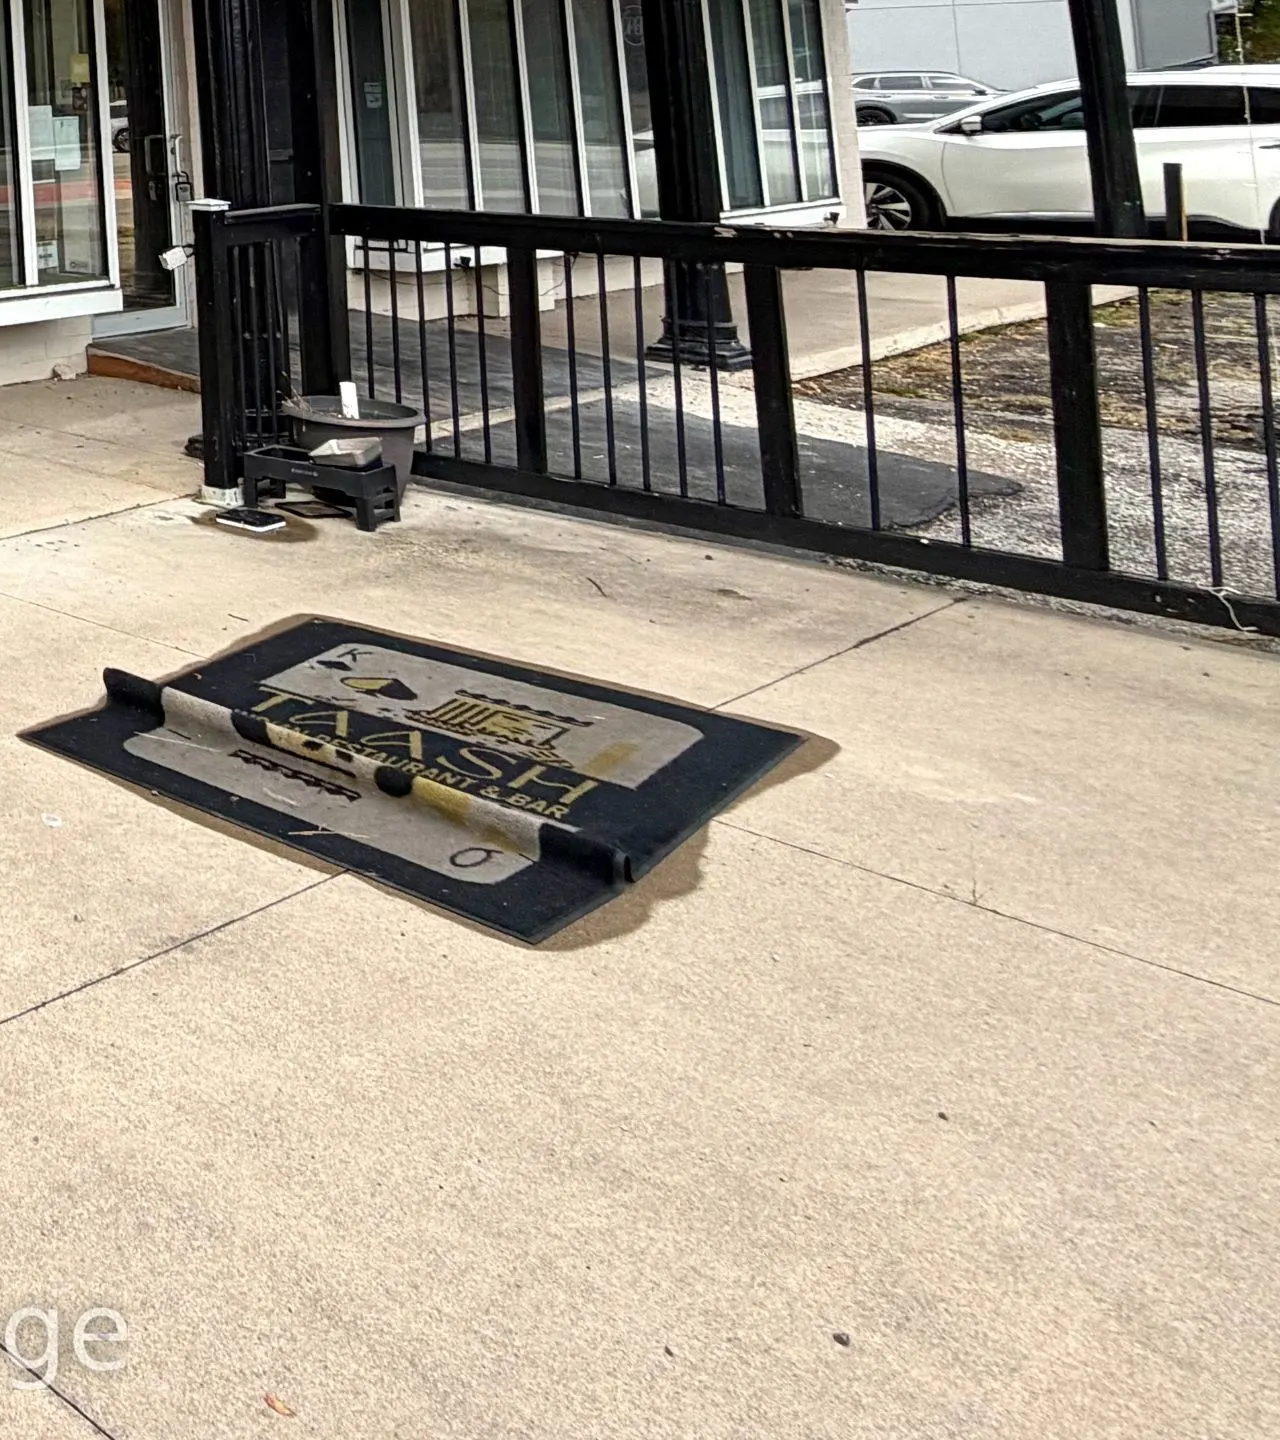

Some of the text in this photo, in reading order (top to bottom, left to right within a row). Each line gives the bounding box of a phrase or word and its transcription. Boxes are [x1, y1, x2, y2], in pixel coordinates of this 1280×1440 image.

[336, 647, 374, 663] K
[251, 685, 600, 805] TAASH
[505, 792, 570, 820] BAR
